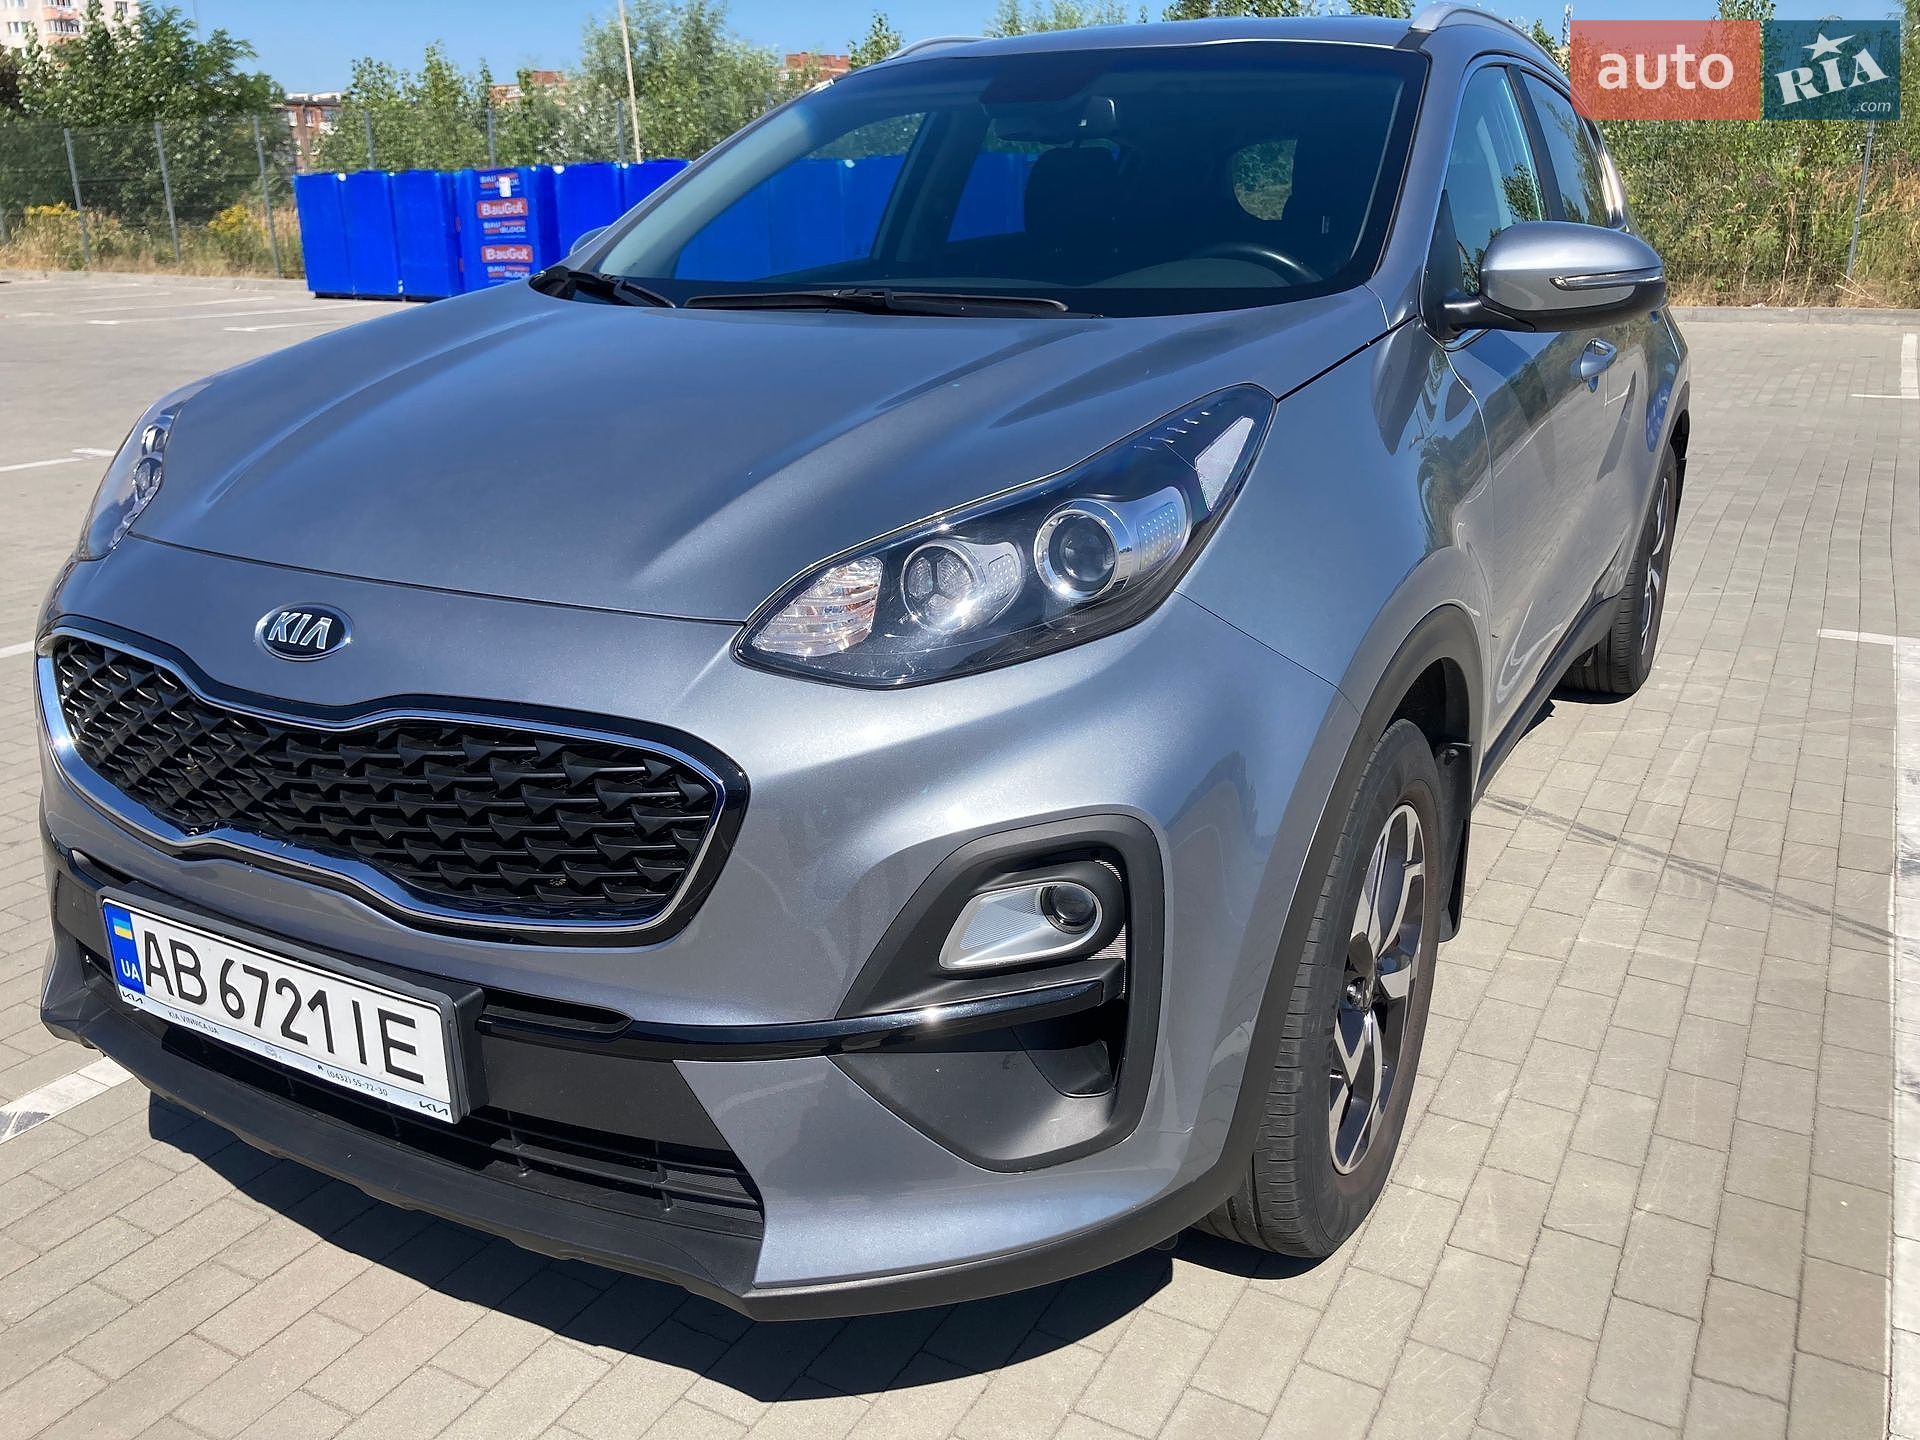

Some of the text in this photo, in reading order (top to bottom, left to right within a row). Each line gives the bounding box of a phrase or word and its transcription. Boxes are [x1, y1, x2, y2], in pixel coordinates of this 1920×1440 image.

[481, 202, 525, 216] BauGut
[485, 247, 529, 261] BauGut
[267, 611, 333, 650] KIA
[120, 957, 142, 983] UA
[144, 930, 424, 1085] AB 6721 IE
